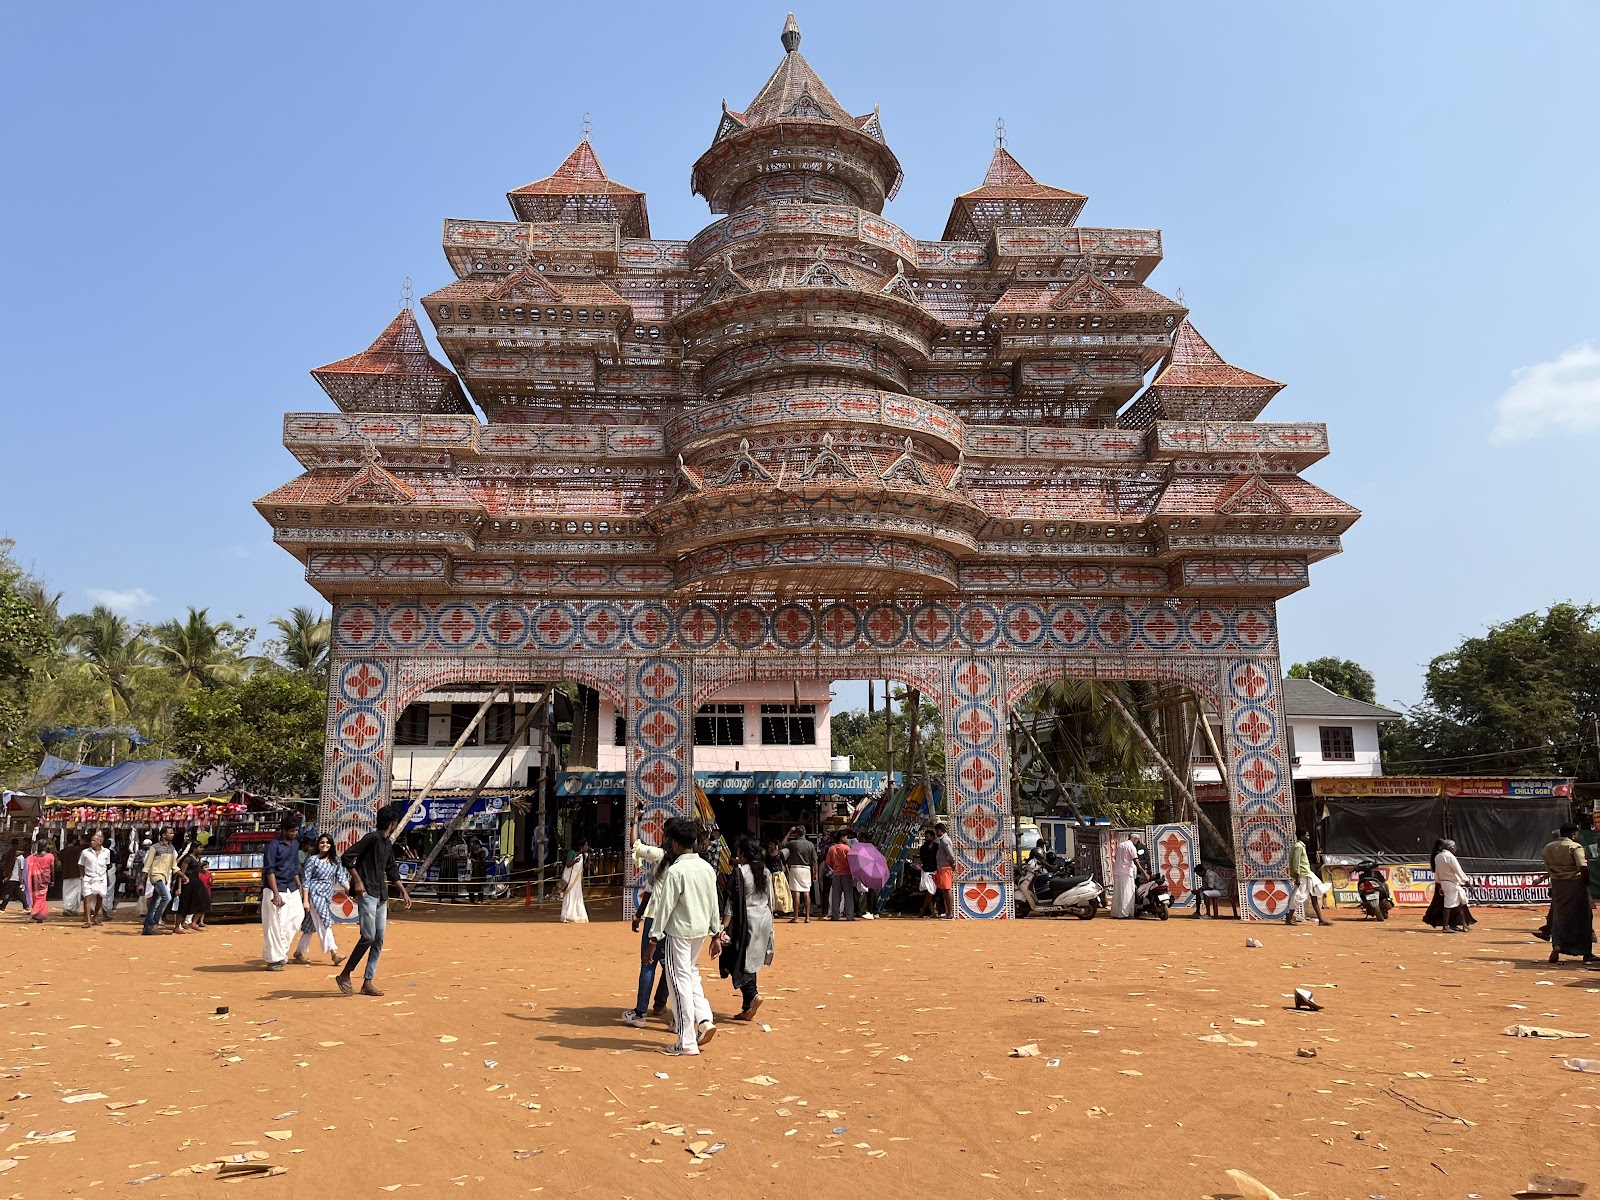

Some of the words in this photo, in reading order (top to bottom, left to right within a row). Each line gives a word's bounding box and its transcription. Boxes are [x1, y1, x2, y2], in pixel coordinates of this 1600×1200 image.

[1414, 870, 1426, 880] PANI
[1488, 875, 1523, 886] CHILLY
[1488, 887, 1524, 900] FLOWER
